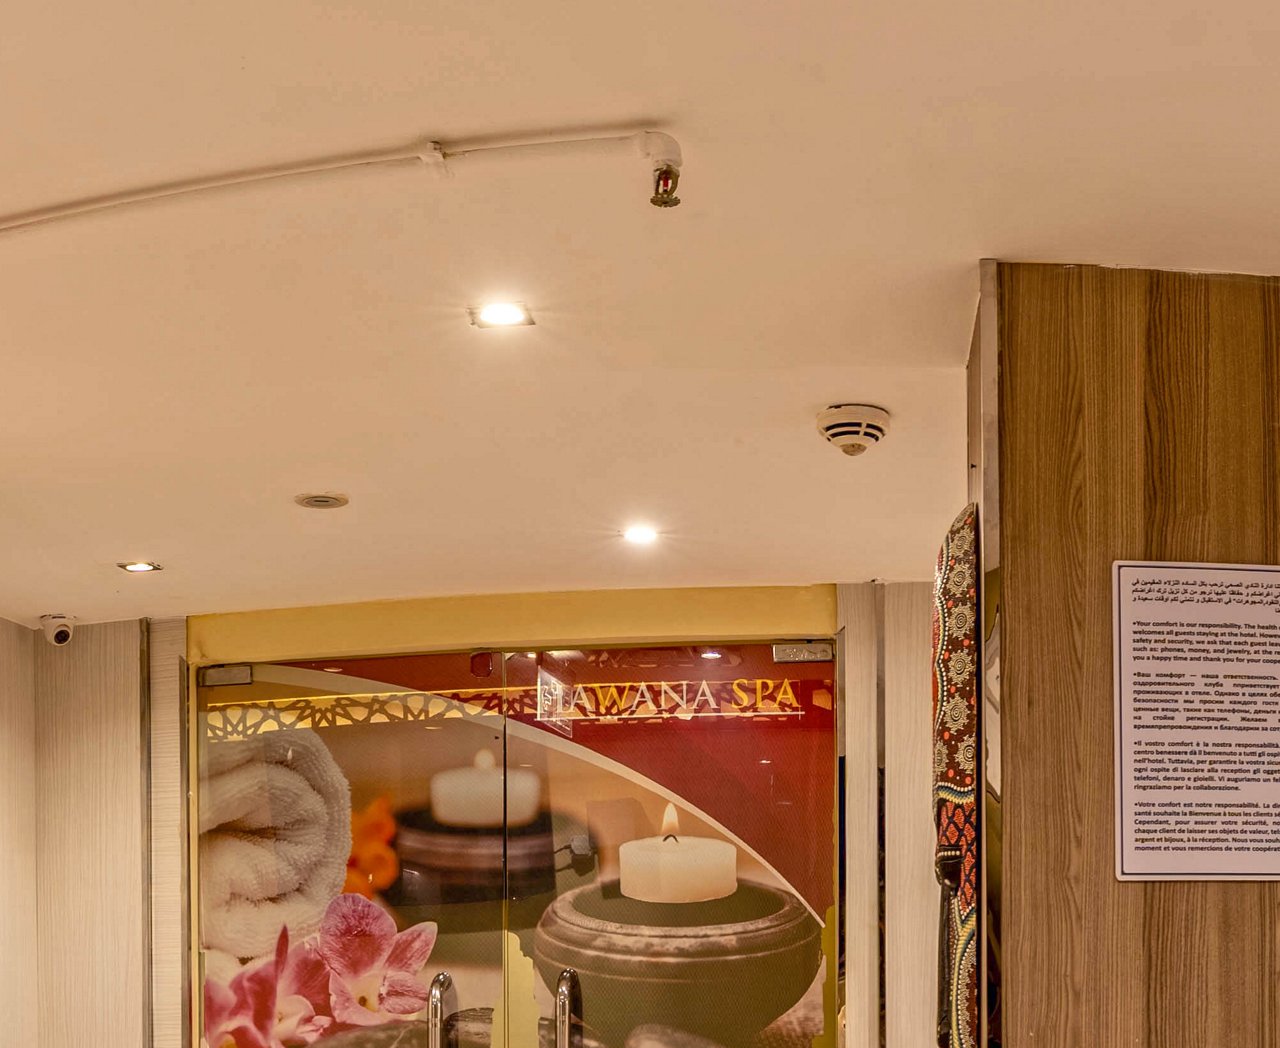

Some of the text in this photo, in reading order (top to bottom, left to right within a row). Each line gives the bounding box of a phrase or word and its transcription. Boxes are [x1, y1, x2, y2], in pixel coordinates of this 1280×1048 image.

[1196, 630, 1218, 638] staying
[1132, 636, 1152, 645] safety
[1167, 637, 1193, 645] security,
[1160, 645, 1186, 654] phones,
[1226, 647, 1251, 656] jewelry,
[731, 678, 801, 709] SPA
